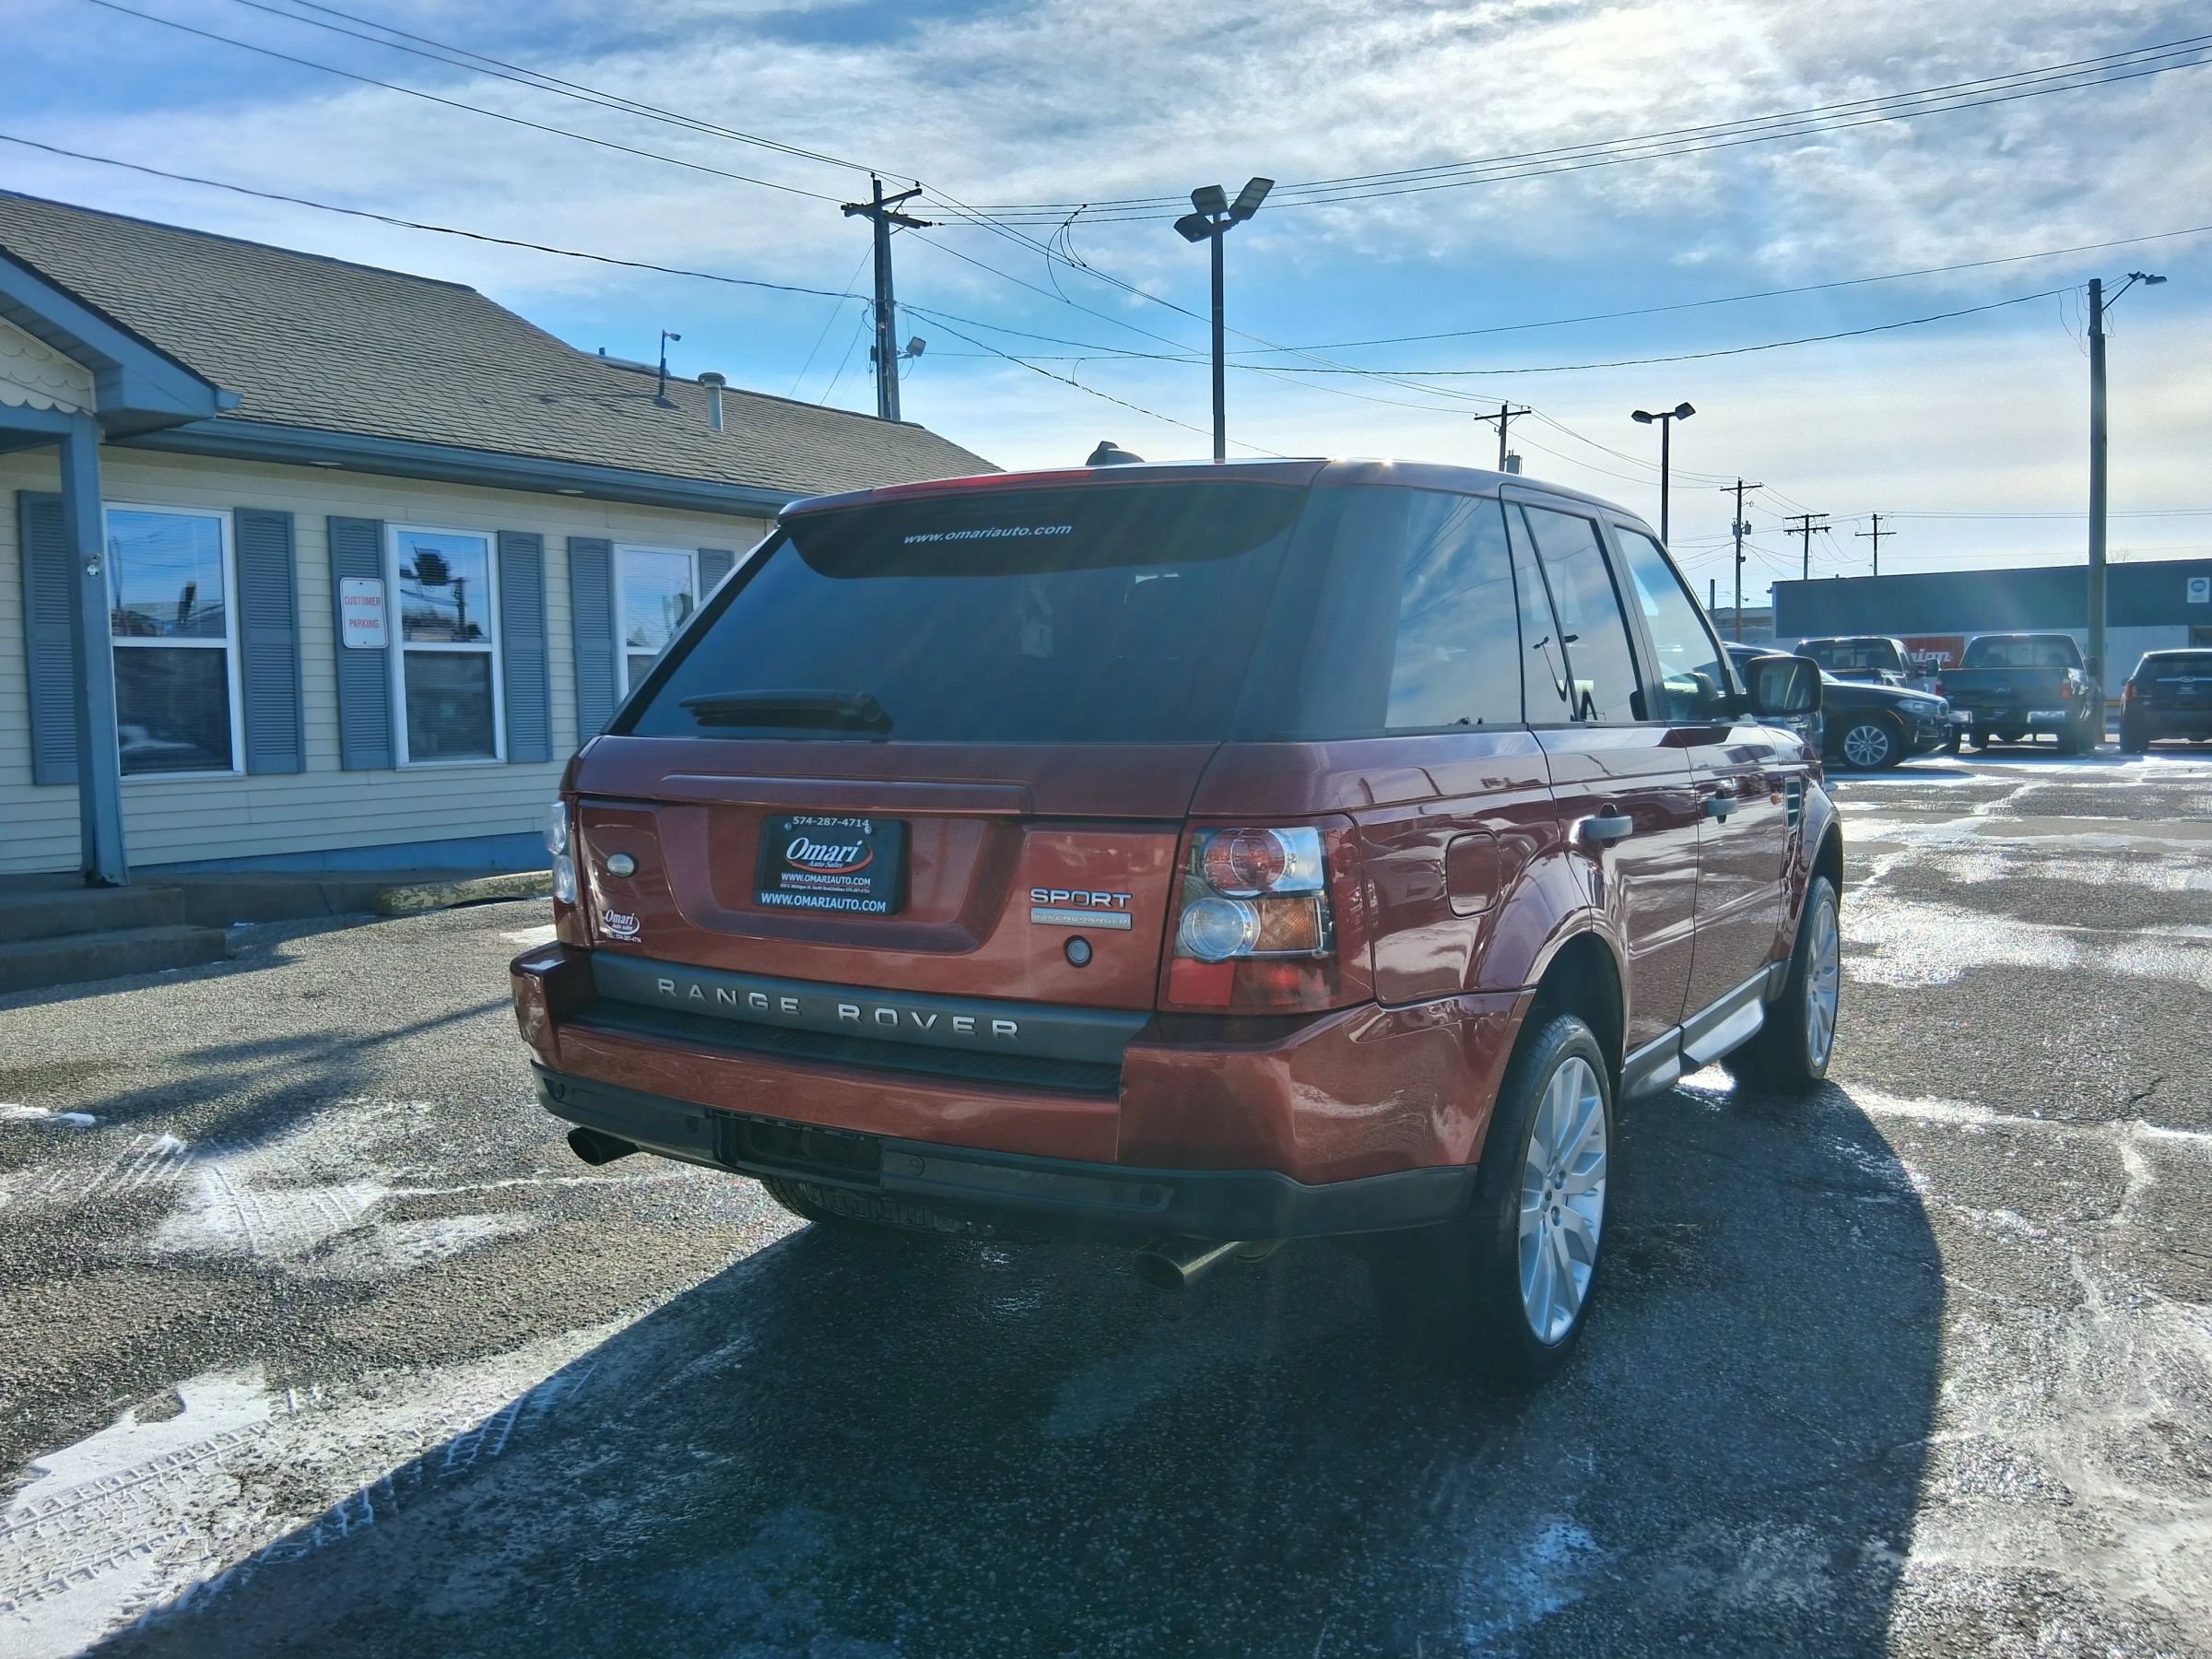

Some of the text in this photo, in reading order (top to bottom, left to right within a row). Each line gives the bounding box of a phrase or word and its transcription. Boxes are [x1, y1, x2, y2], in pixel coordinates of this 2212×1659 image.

[904, 524, 1072, 544] www.omariauto.com
[344, 595, 382, 606] CUSTOMER
[349, 618, 379, 629] PARKING
[793, 816, 869, 828] 574-287-4714
[786, 837, 863, 863] Omari
[782, 873, 871, 886] WWW.OMARIAUTO.COM
[761, 892, 886, 912] WWW.OMARIAUTO.COM
[1030, 888, 1132, 908] SPORT
[606, 909, 634, 925] Omari
[657, 977, 1020, 1040] RANGE ROVER
